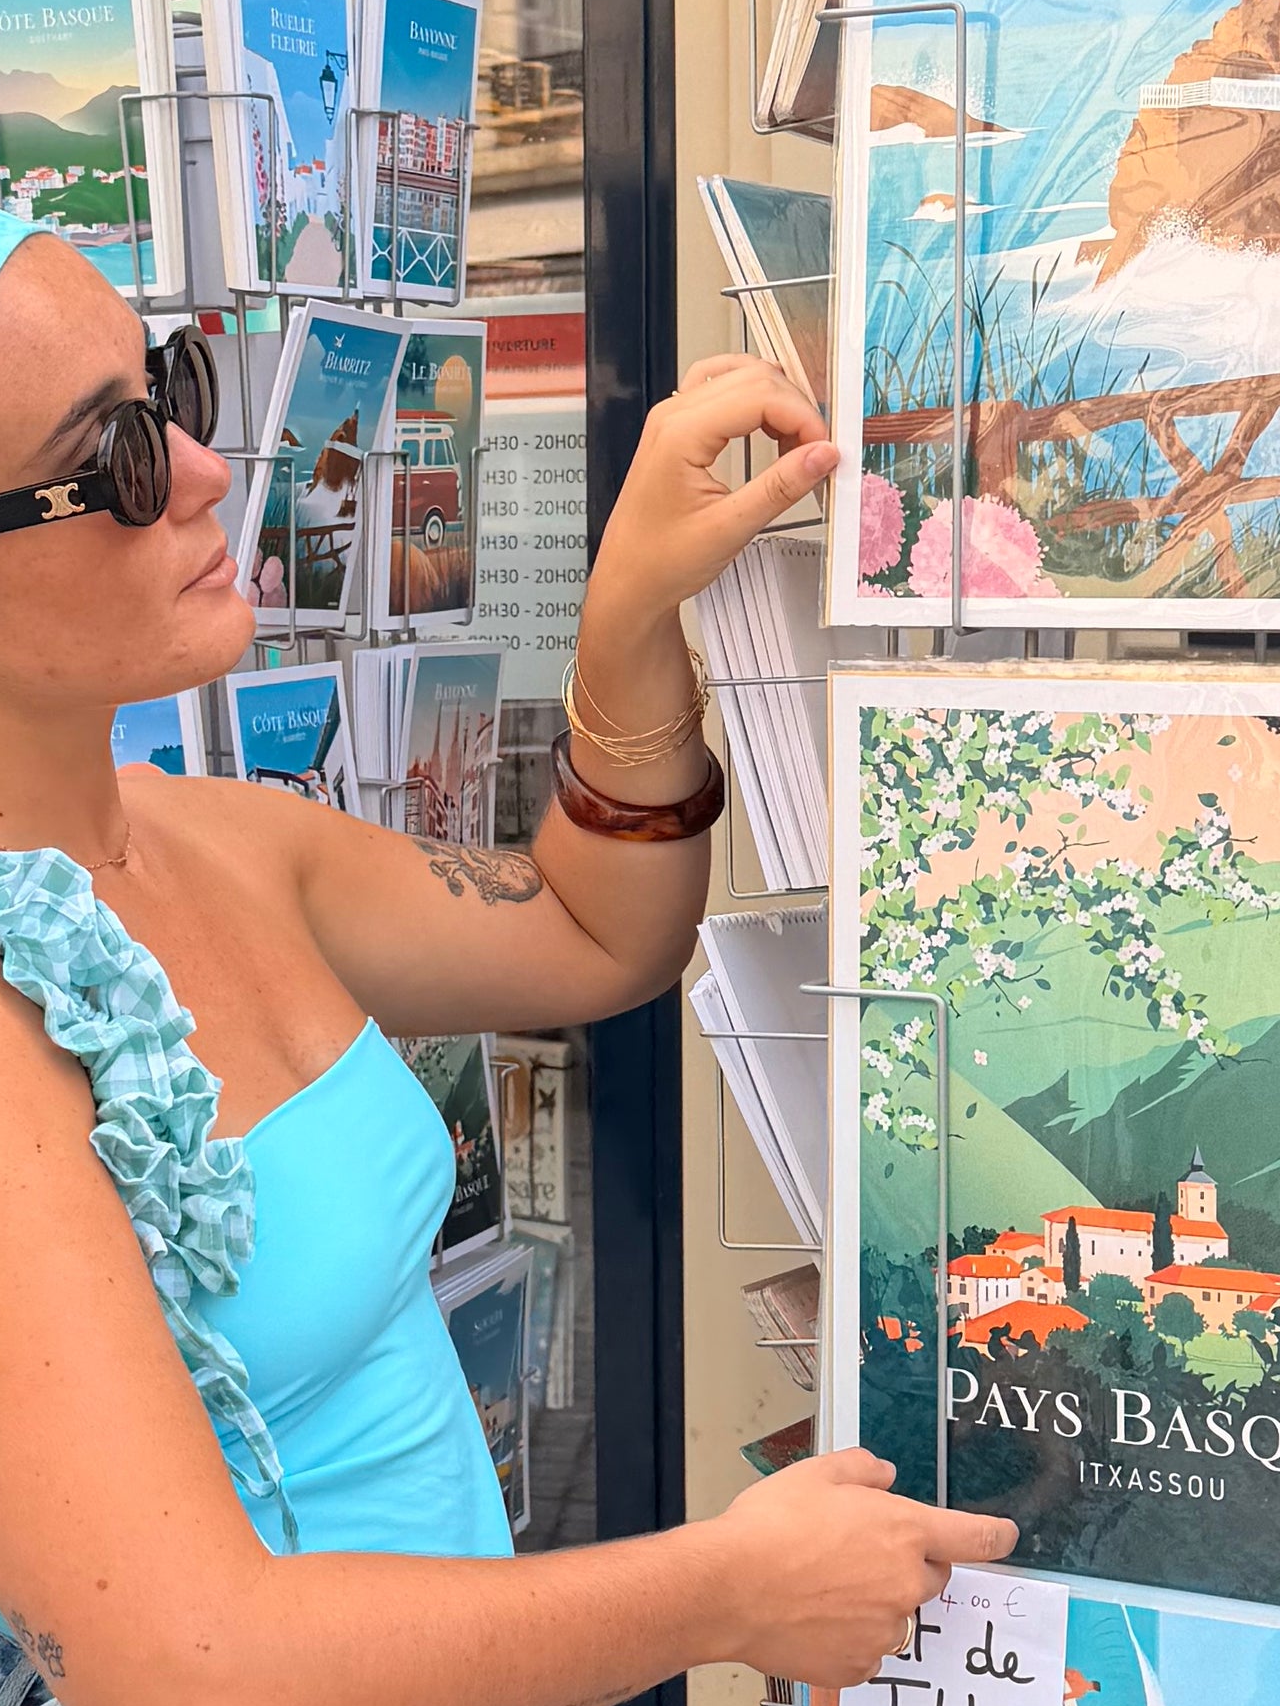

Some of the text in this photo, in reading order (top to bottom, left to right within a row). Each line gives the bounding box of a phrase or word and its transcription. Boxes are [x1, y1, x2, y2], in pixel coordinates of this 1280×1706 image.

[42, 4, 115, 28] BASQUE
[270, 7, 316, 36] RUELLE
[271, 33, 318, 57] FLEURIE
[409, 20, 459, 50] BAYONNE
[324, 351, 372, 375] BIARRITZ
[482, 469, 517, 485] H30
[535, 602, 583, 618] 20H0
[536, 635, 577, 650] 20H0
[252, 707, 331, 734] CÔTE BASQUE
[946, 1367, 1082, 1438] PAYS
[1079, 1461, 1226, 1501] ITXASSOU
[1003, 1586, 1027, 1618] €
[965, 1620, 1035, 1684] de
